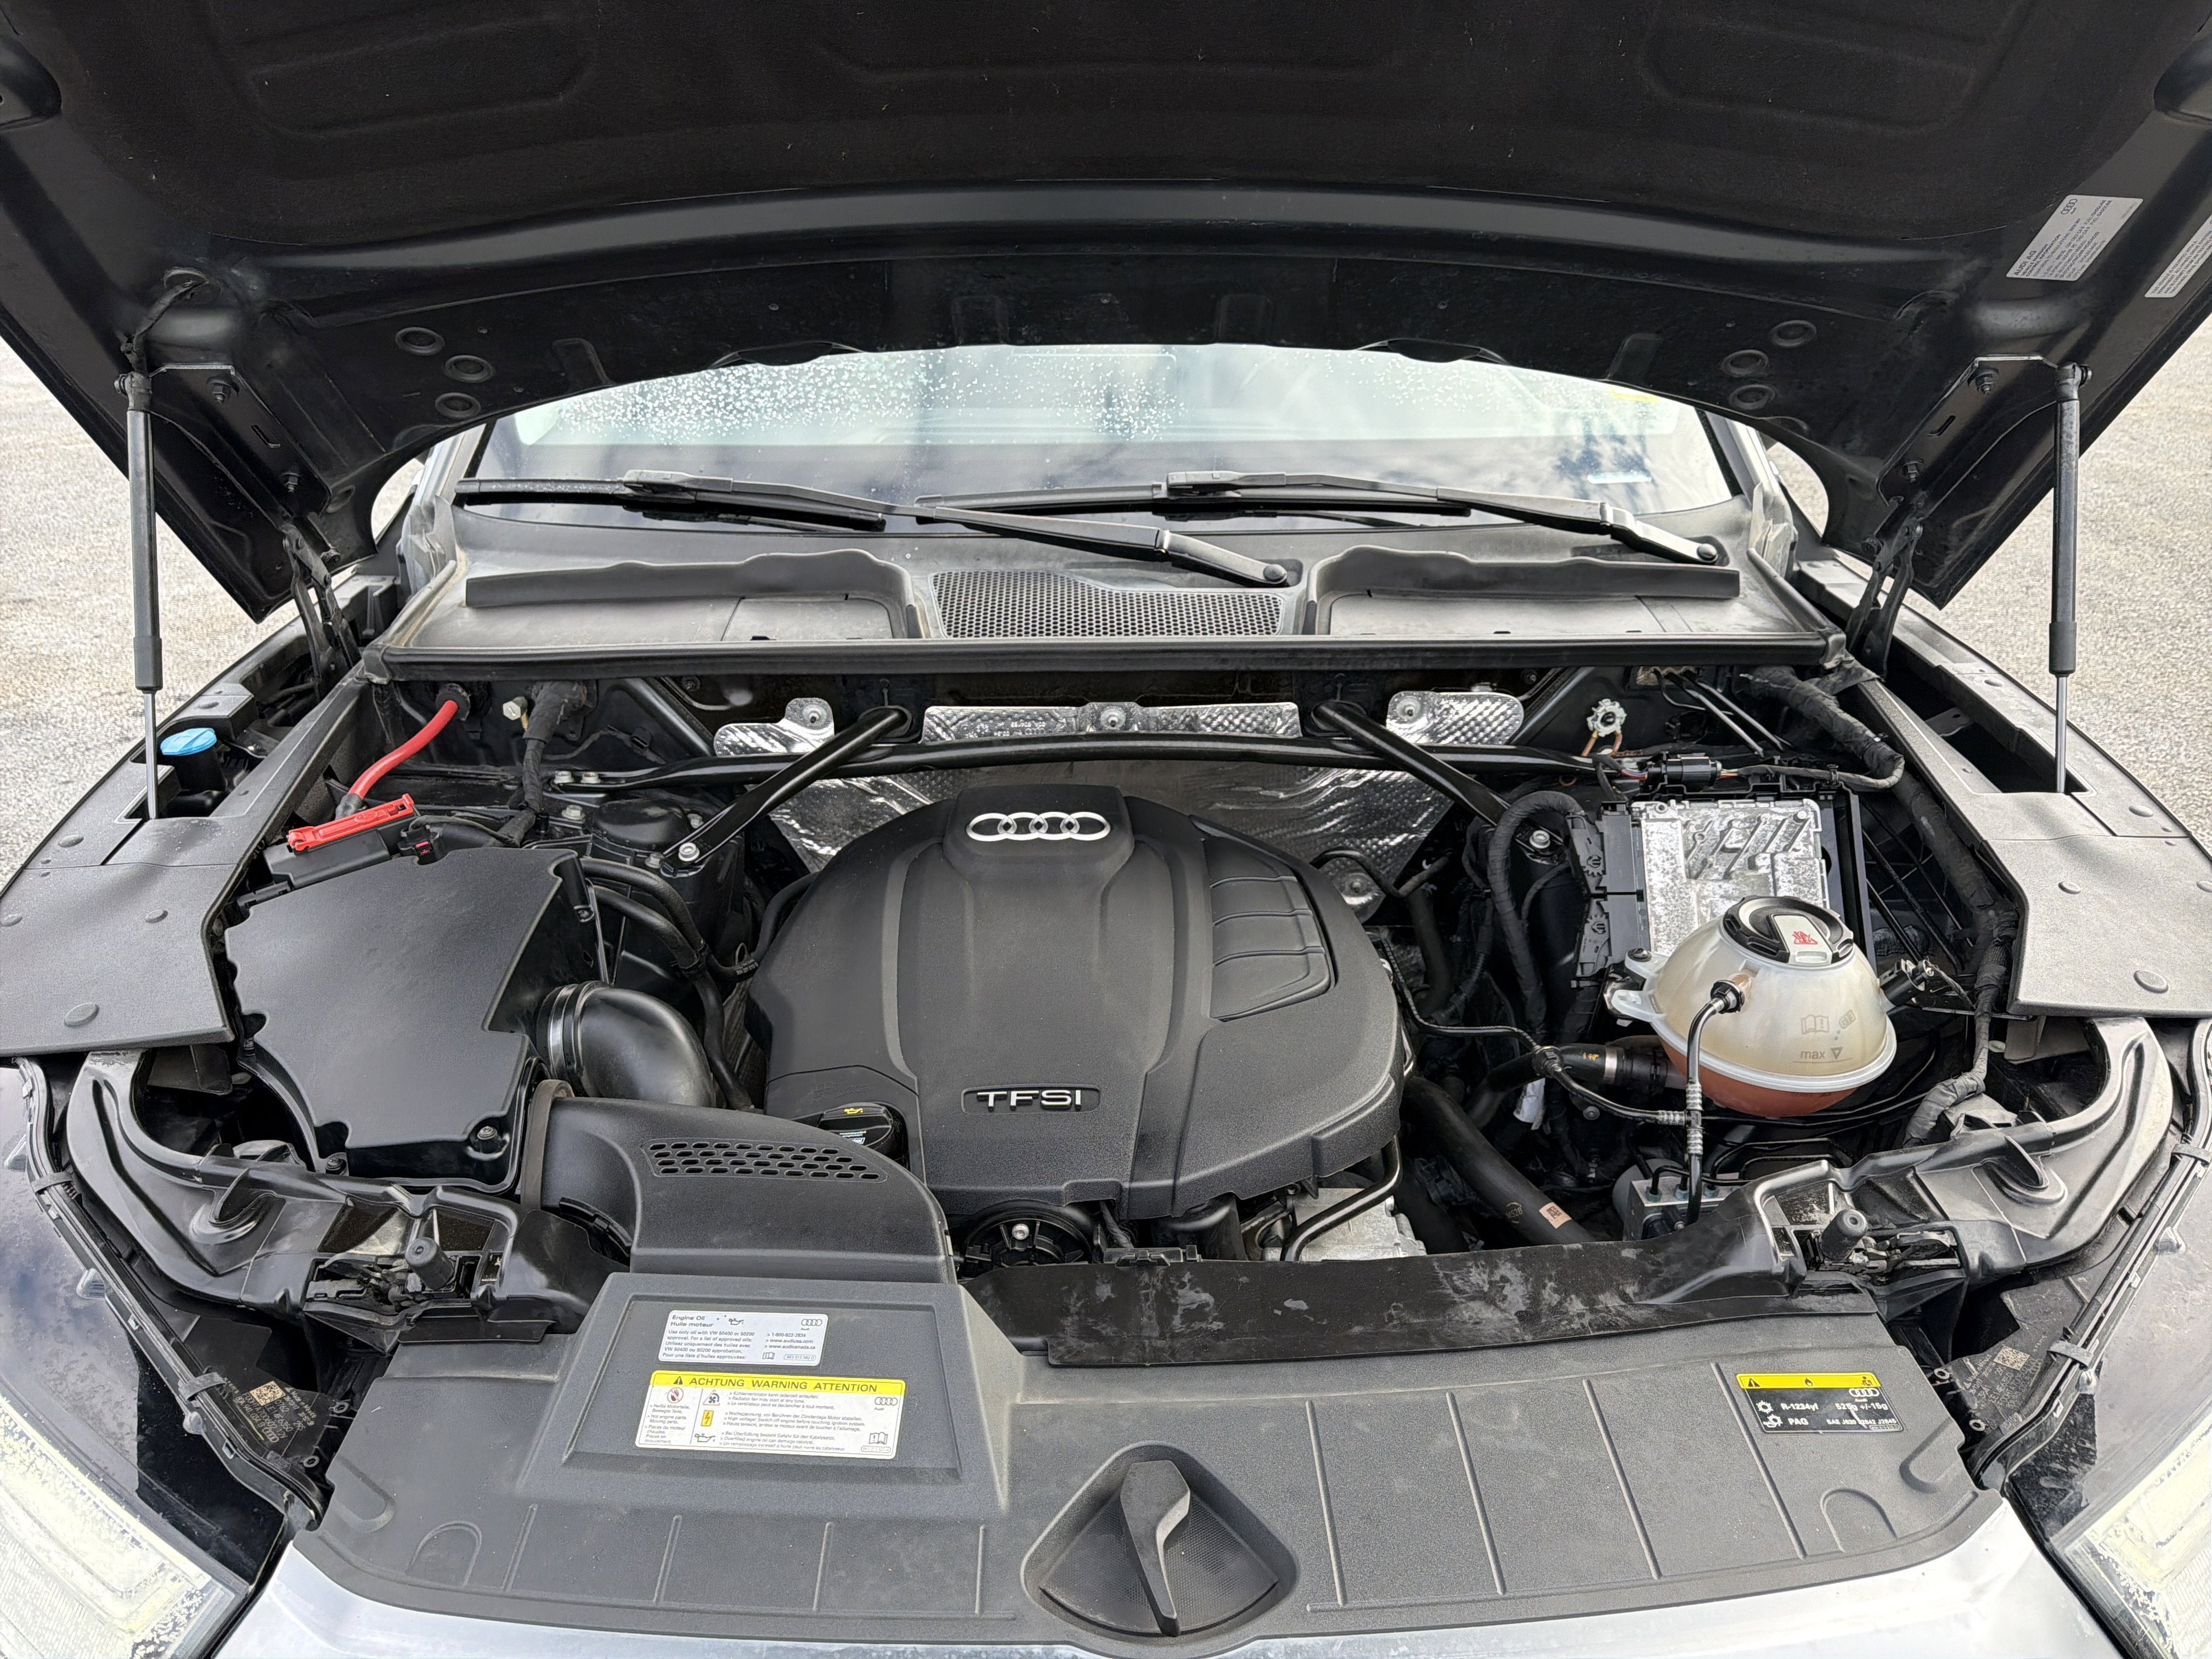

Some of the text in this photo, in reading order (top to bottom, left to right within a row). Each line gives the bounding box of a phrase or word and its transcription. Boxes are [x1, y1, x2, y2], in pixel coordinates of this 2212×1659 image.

[2013, 251, 2036, 275] AUDI AG
[1801, 1051, 1825, 1059] max
[977, 1090, 1082, 1110] TFSI
[689, 1378, 877, 1392] ACHTUNG WARNING ATTENTION
